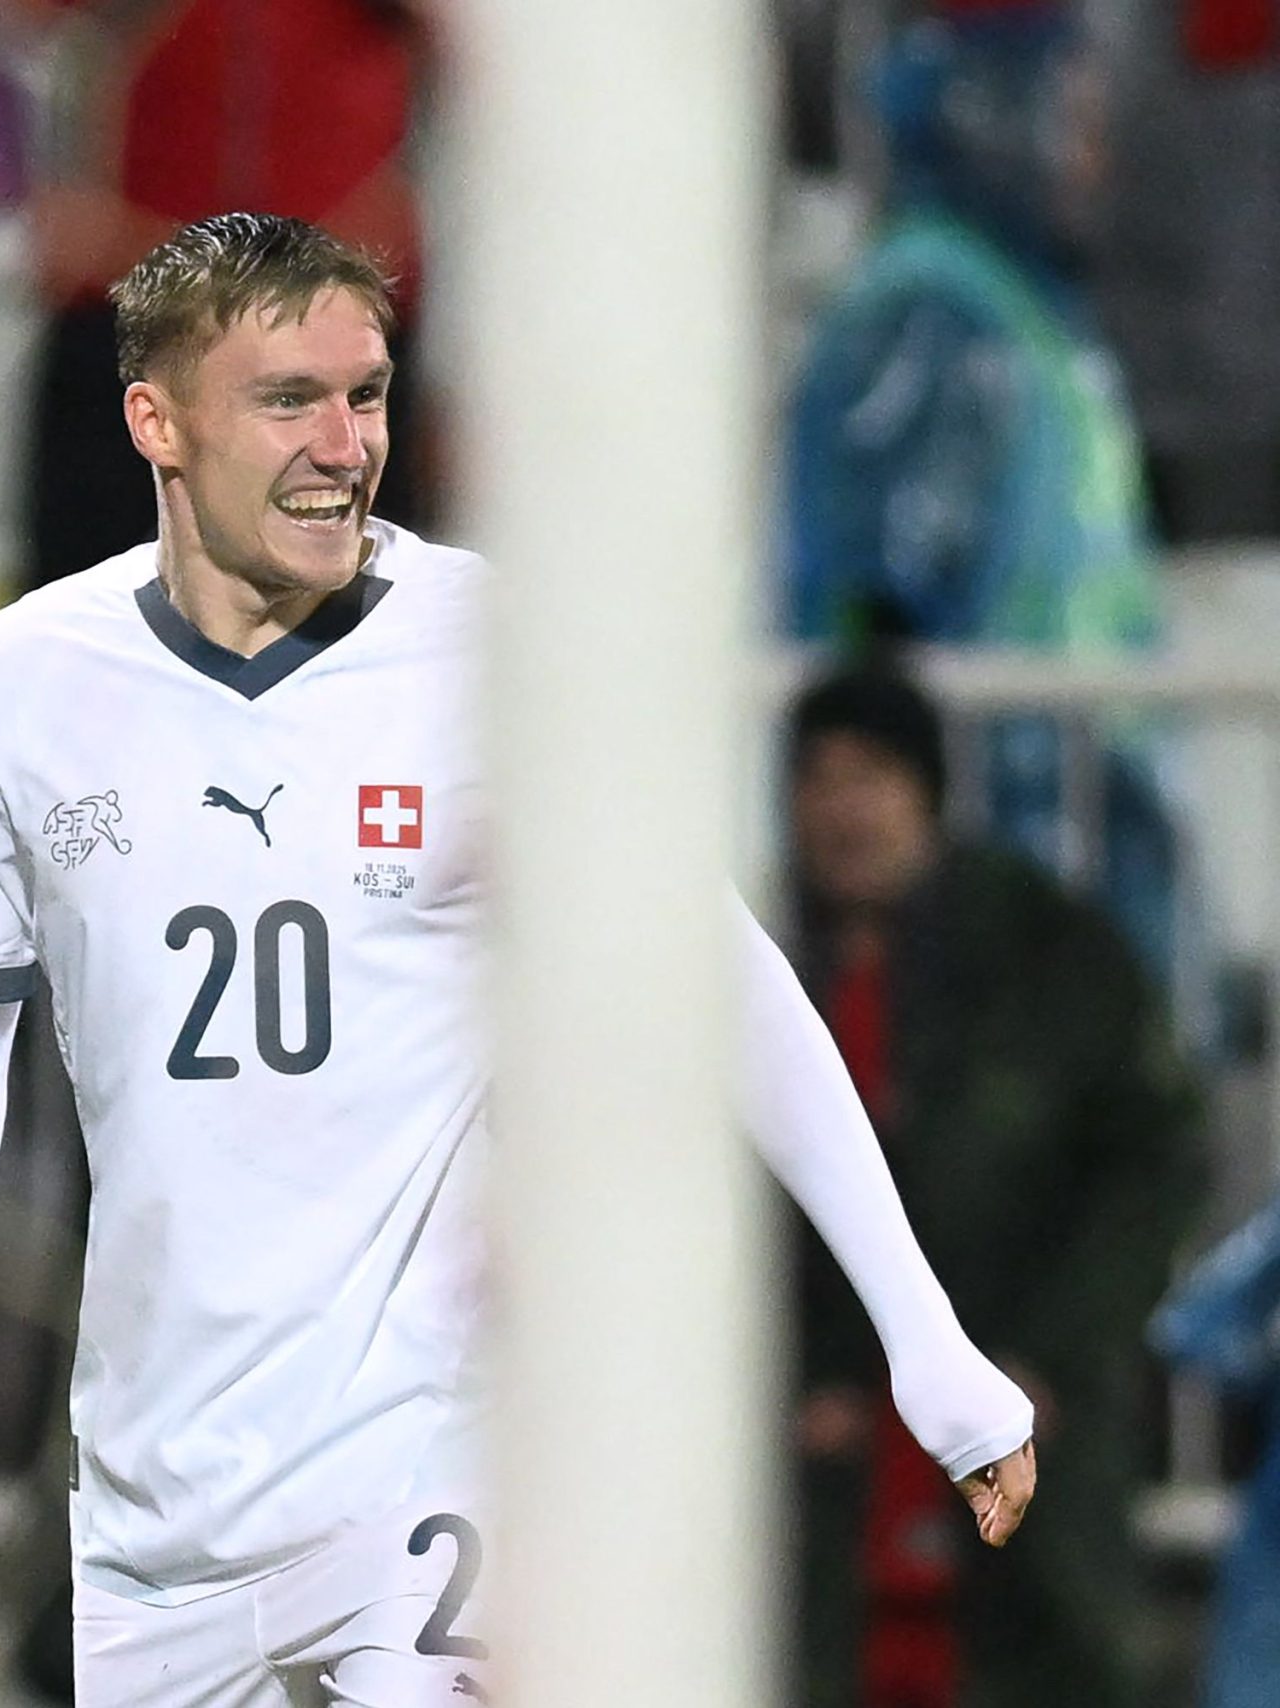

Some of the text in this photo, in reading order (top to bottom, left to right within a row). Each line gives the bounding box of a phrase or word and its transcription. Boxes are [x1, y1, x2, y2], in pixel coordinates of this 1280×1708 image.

[353, 872, 379, 887] KOS
[395, 875, 415, 890] SUI
[165, 899, 332, 1080] 20
